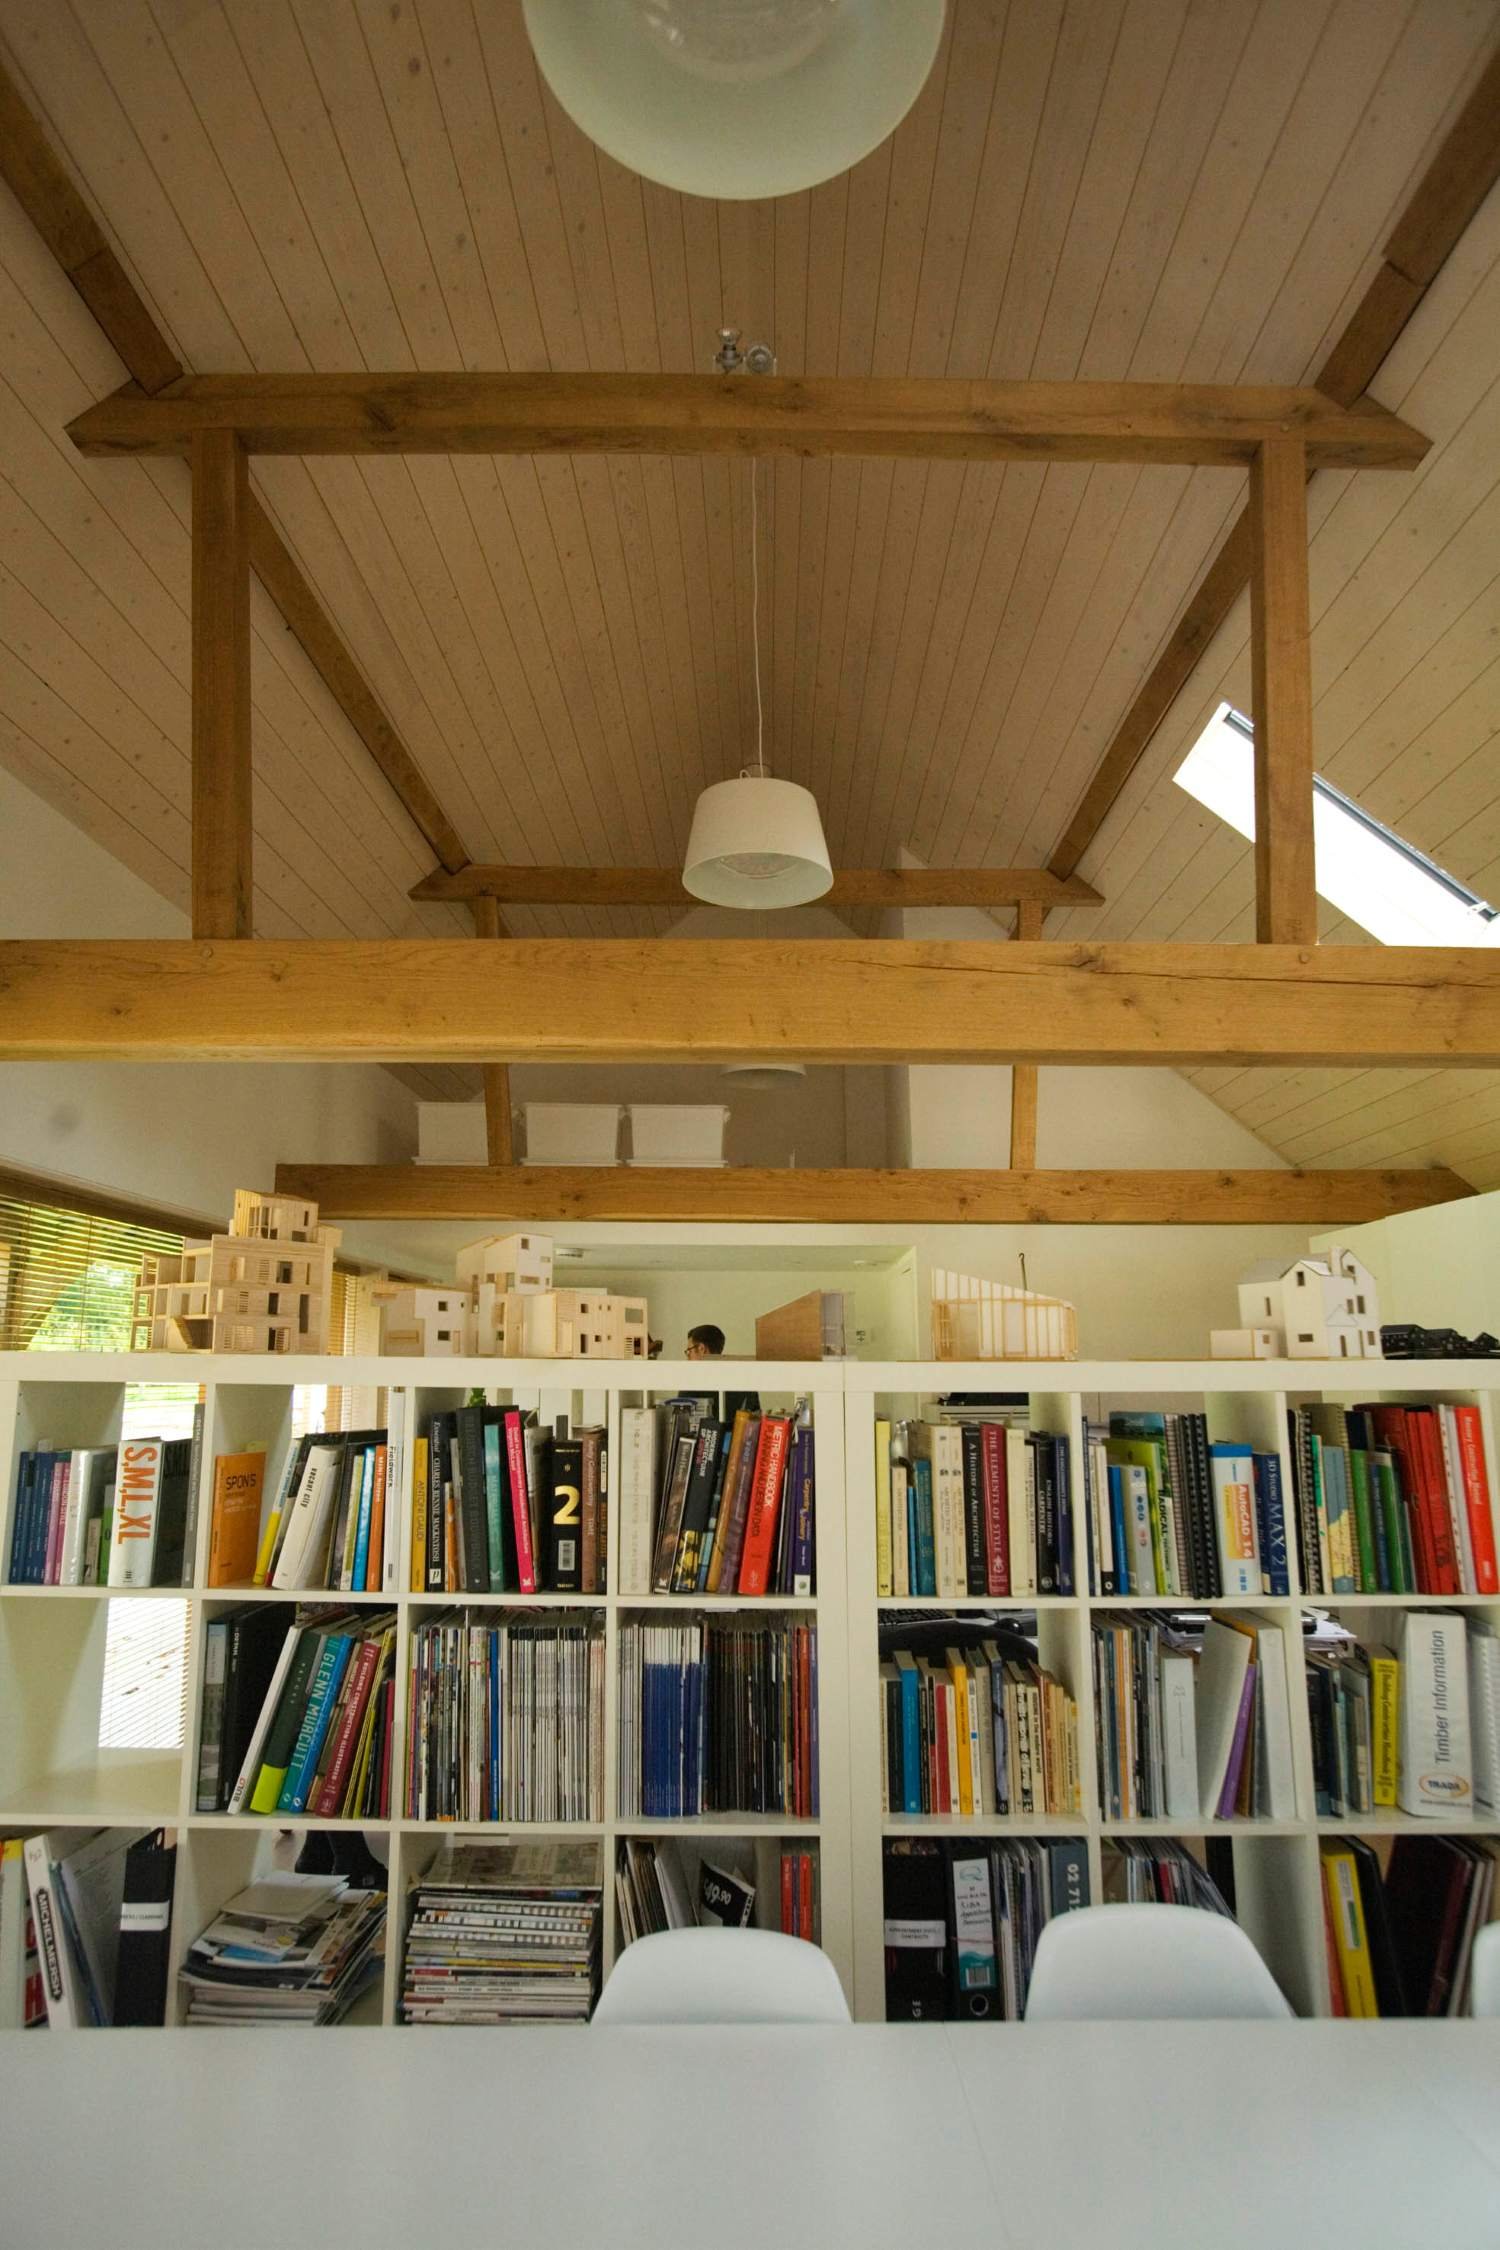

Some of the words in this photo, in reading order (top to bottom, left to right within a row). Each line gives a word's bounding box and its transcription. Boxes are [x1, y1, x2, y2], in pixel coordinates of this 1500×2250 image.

[433, 1421, 441, 1452] Essential
[586, 1440, 594, 1458] Andy
[760, 1425, 773, 1467] PLANNING
[770, 1426, 783, 1458] METRIC
[989, 1431, 997, 1450] THE
[305, 1467, 318, 1492] vacant
[388, 1445, 397, 1488] Fieldwork
[433, 1457, 441, 1489] CHARLES
[586, 1461, 594, 1506] Goldsworthy
[757, 1468, 769, 1485] AND
[765, 1459, 779, 1509] HANDBOOK
[990, 1454, 999, 1504] ELEMENTS
[1269, 1460, 1276, 1471] 3D
[118, 1447, 158, 1545] S,M,L,XL
[300, 1494, 311, 1508] city
[416, 1480, 424, 1513] ANTONI
[514, 1450, 523, 1488] Contemporary
[521, 1520, 529, 1554] Architecture
[553, 1485, 580, 1525] 2
[754, 1486, 766, 1517] DESIGN
[802, 1478, 812, 1512] Carpentry
[1158, 1489, 1168, 1537] RADICAL
[1238, 1485, 1250, 1536] AutoCAD
[751, 1518, 761, 1537] DATA
[971, 1498, 979, 1557] ARCHITECTURE
[992, 1509, 1000, 1520] OF
[1268, 1503, 1284, 1548] MAX
[993, 1524, 1001, 1553] STYLE
[1243, 1541, 1252, 1557] 14
[1272, 1554, 1286, 1566] 2
[311, 1652, 336, 1700] GLENN
[356, 1662, 369, 1691] BUILDING
[1431, 1629, 1448, 1710] Information
[343, 1692, 361, 1739] CONSTRUCTION
[291, 1703, 320, 1770] MURCUTT
[1434, 1716, 1451, 1764] Timber
[332, 1740, 349, 1780] ILLUSTRATED
[1067, 1863, 1079, 1882] 02
[38, 1893, 61, 1996] MICHELMERSH
